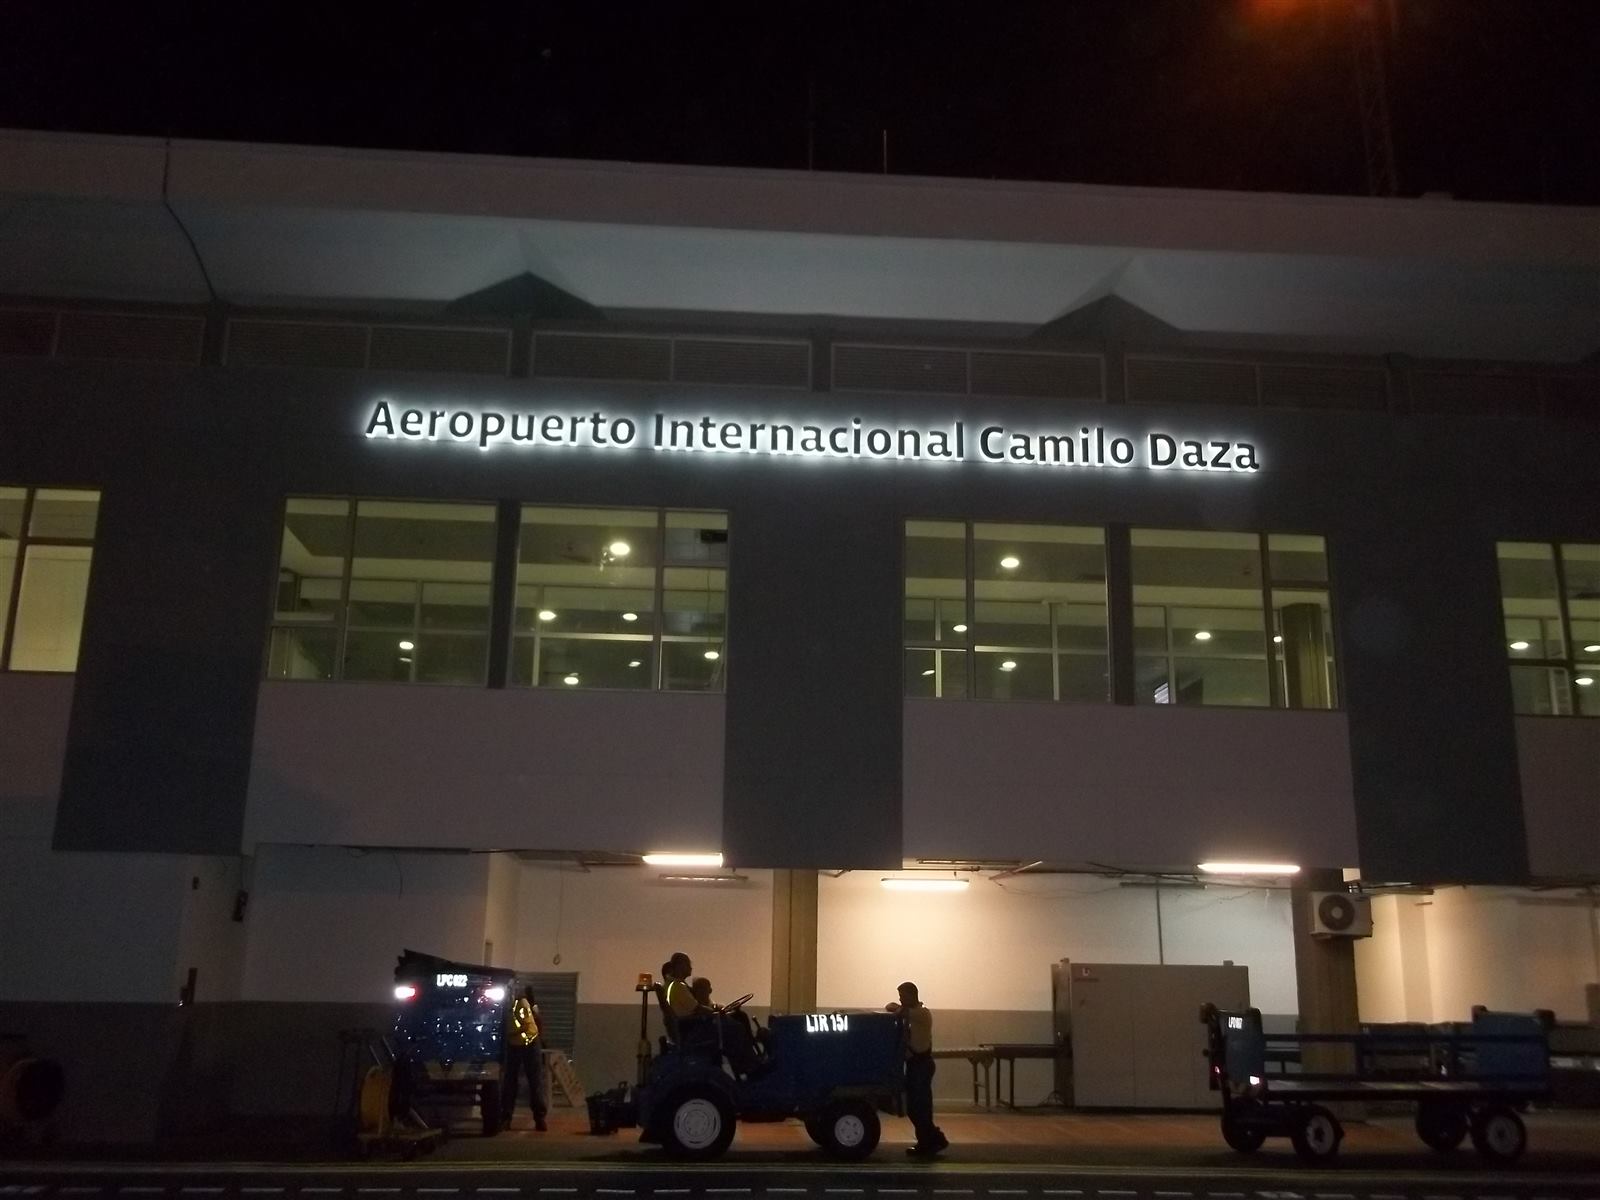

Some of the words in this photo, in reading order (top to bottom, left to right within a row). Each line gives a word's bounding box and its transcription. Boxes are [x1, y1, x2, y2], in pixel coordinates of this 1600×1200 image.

[365, 399, 637, 450] Aeropuerto
[653, 412, 966, 463] Internacional
[981, 426, 1135, 468] Camilo
[1149, 431, 1261, 472] Daza
[806, 1013, 829, 1033] LTR
